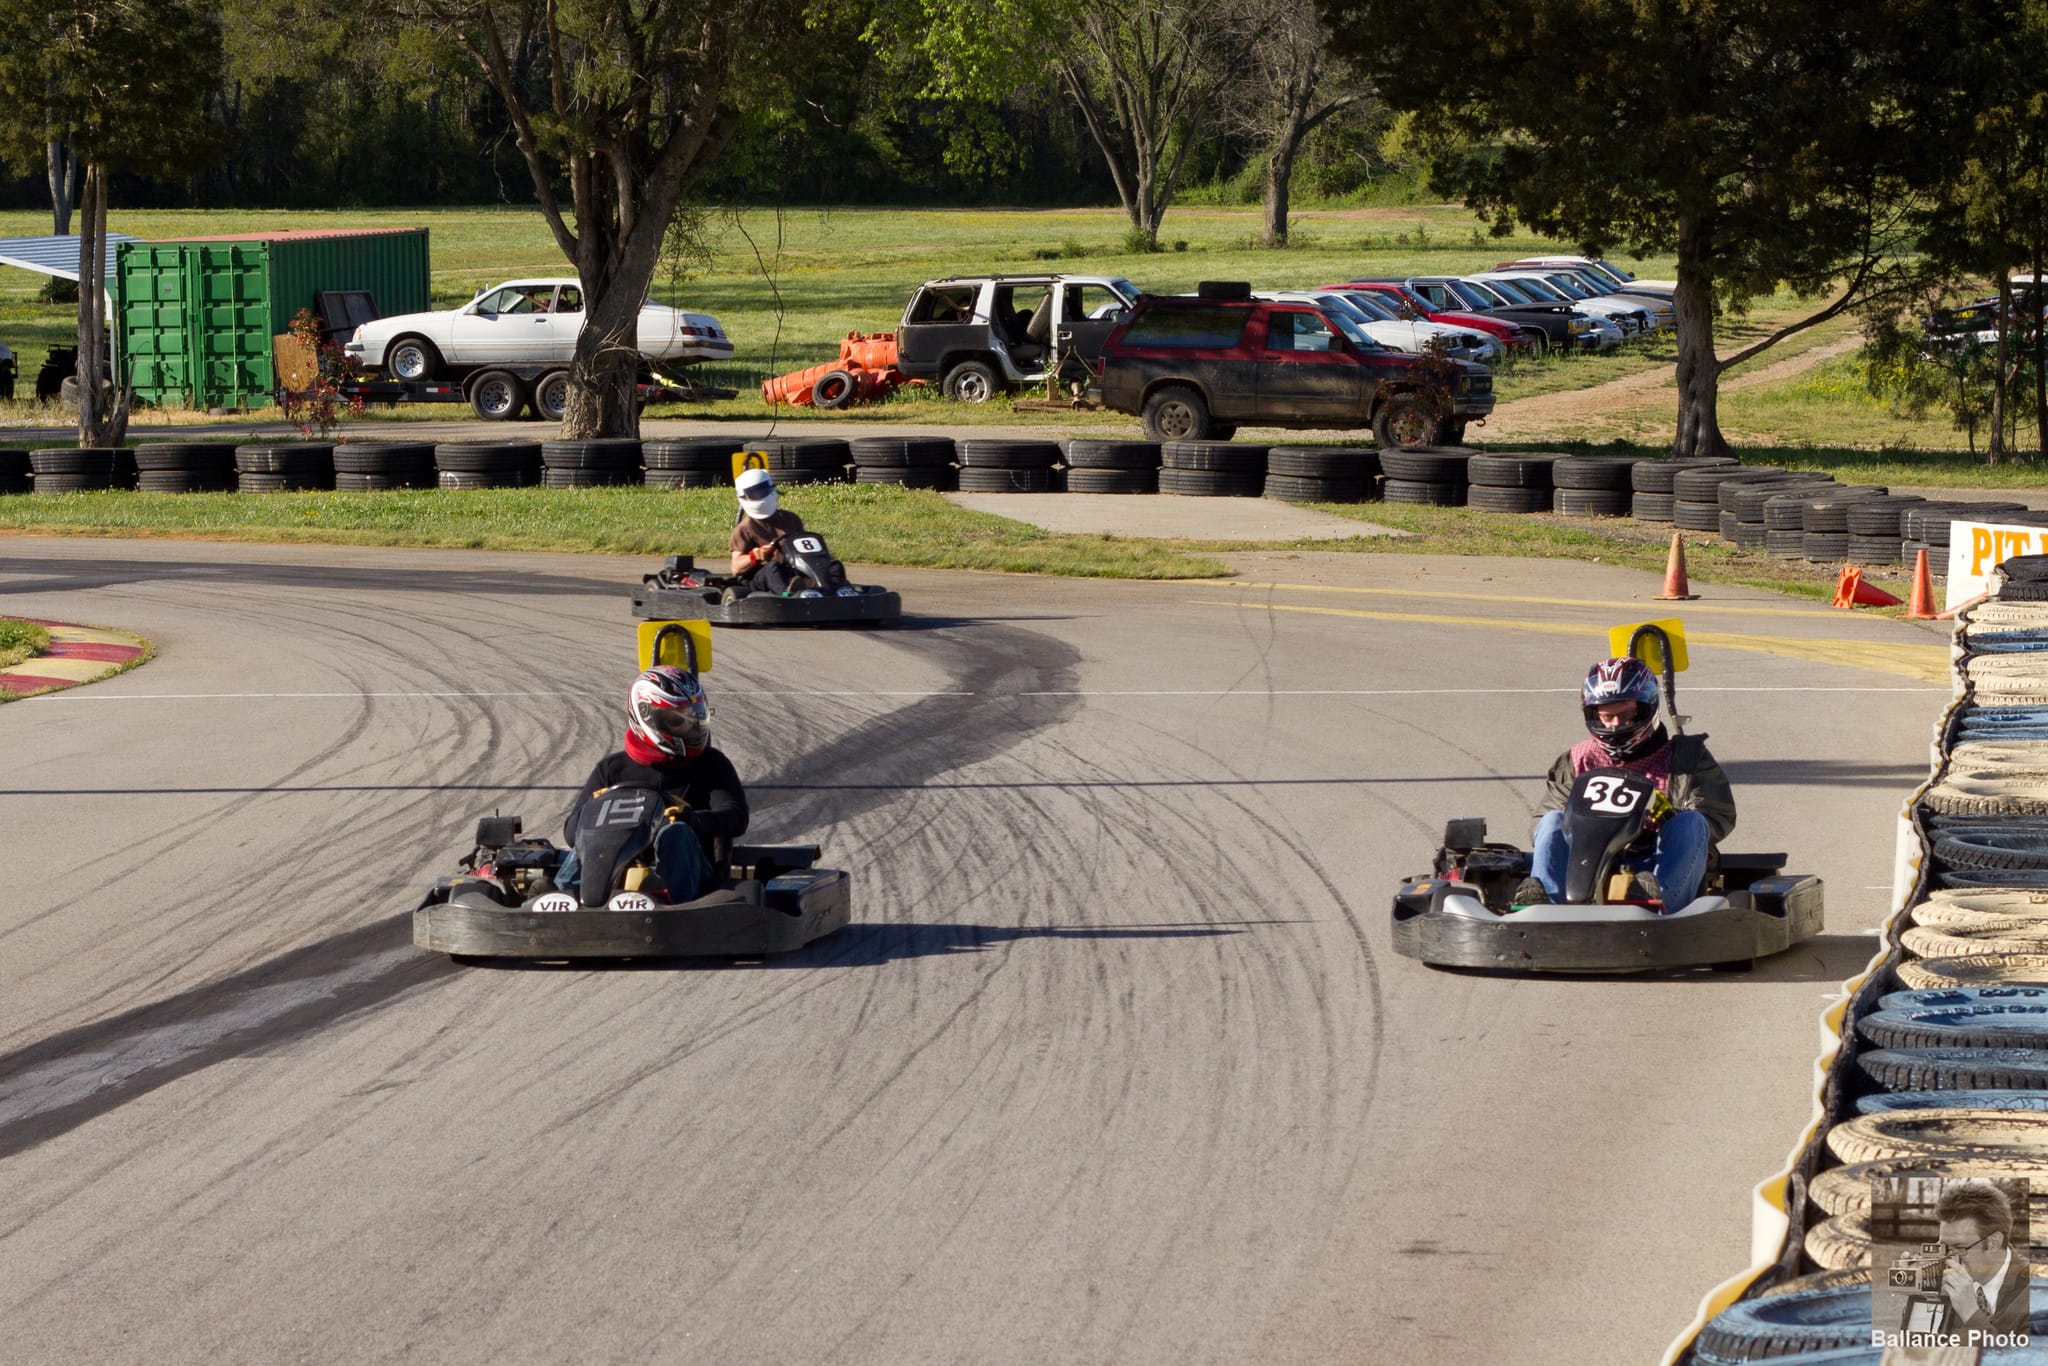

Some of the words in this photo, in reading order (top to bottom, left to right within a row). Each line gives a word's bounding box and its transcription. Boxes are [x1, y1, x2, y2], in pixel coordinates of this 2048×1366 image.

[801, 539, 815, 550] 8
[1971, 527, 2030, 576] PIT
[1588, 780, 1634, 807] 36
[595, 797, 645, 827] 15
[540, 901, 570, 911] VIR
